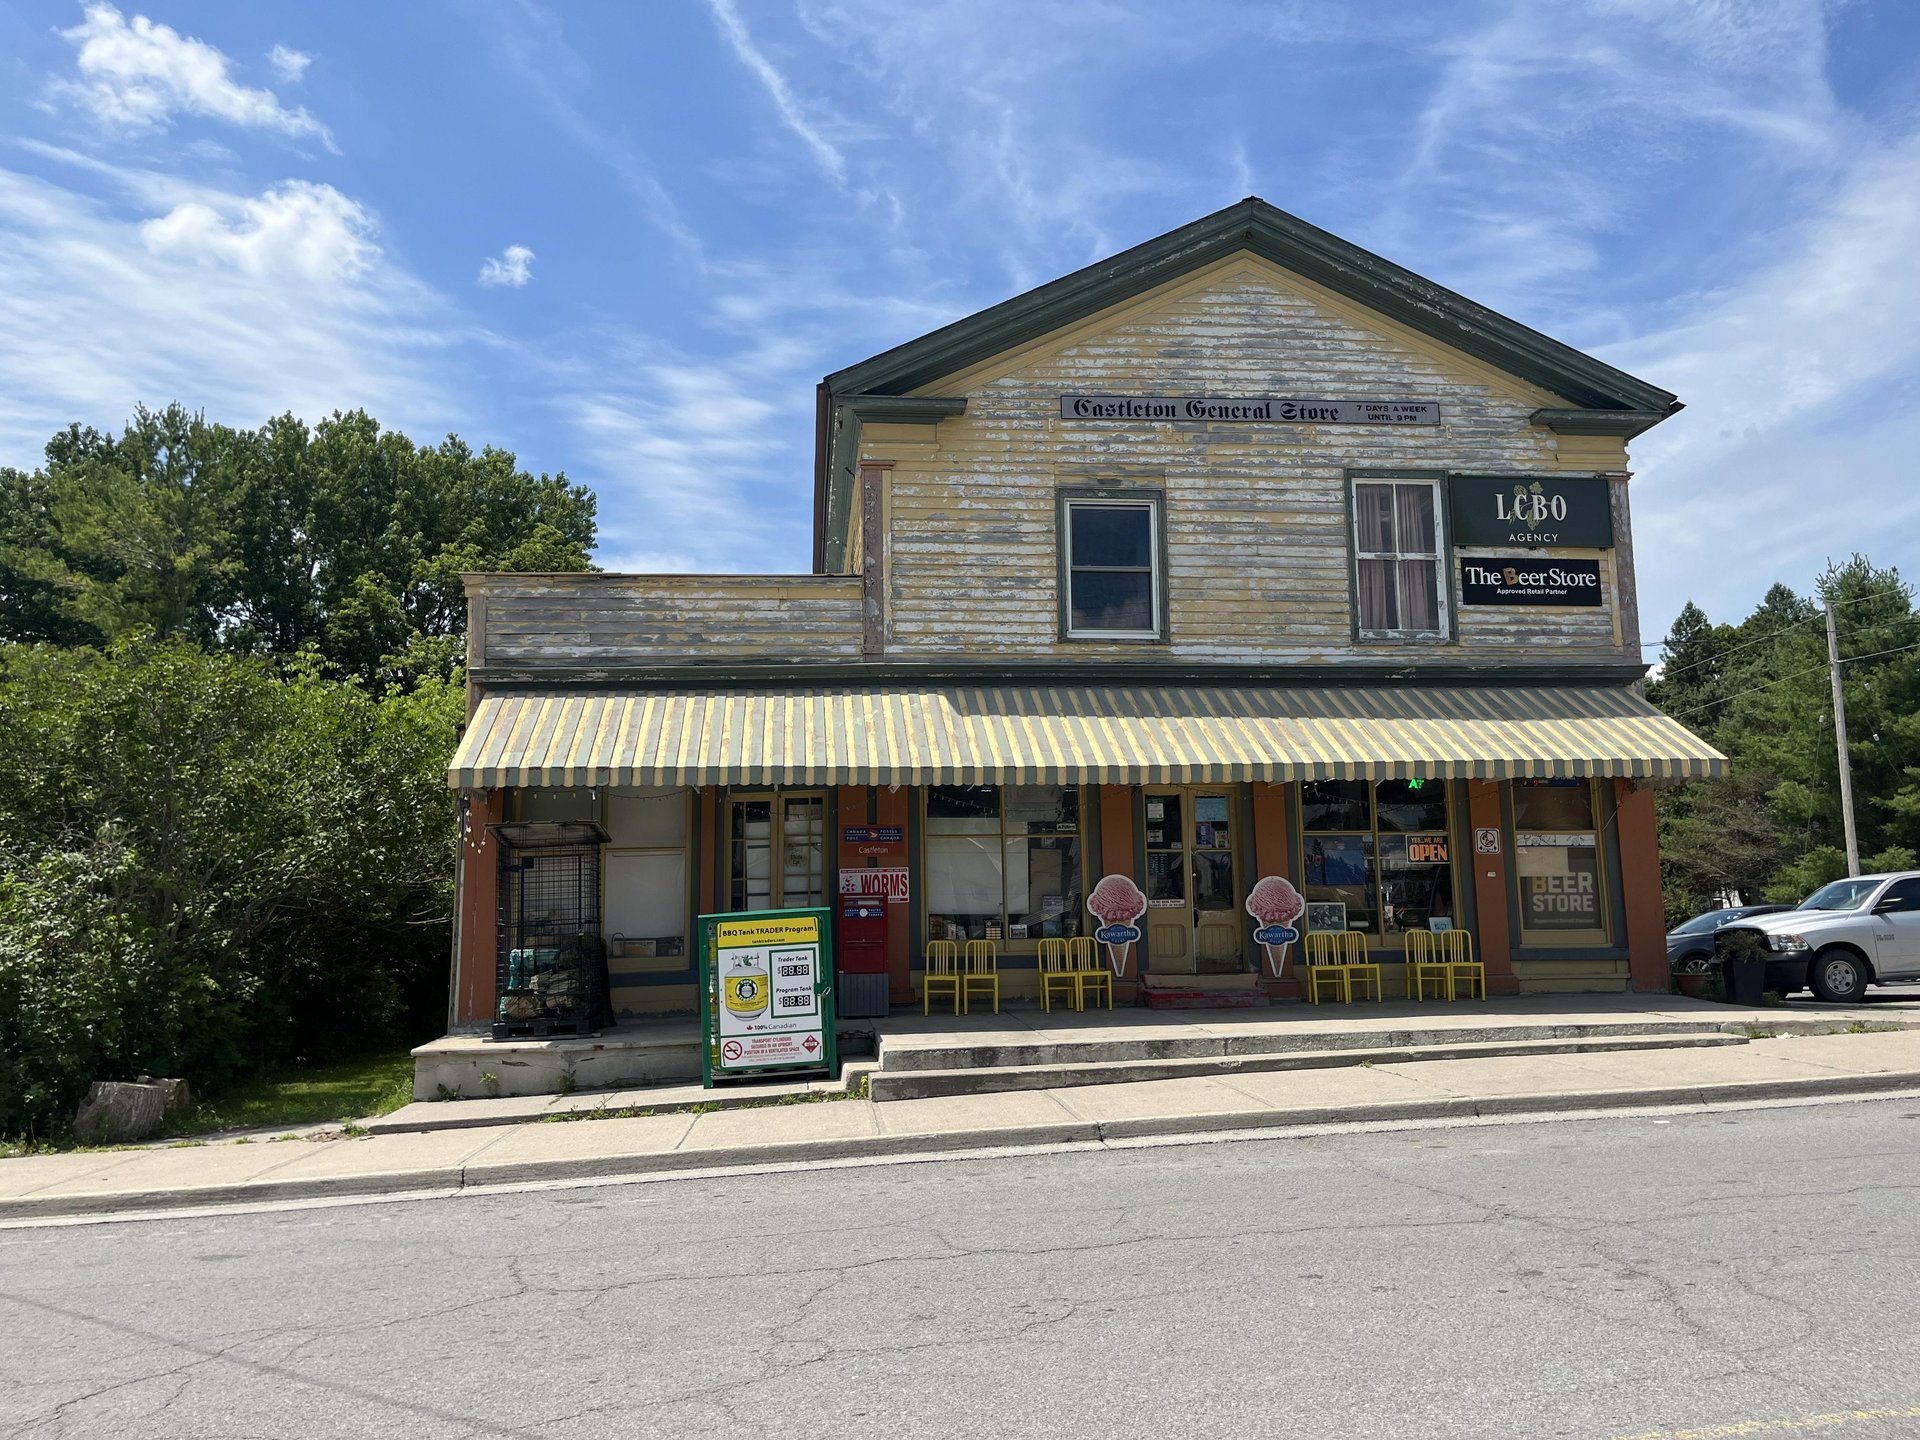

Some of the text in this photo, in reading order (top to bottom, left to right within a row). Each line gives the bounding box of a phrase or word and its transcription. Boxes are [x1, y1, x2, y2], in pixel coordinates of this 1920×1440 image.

[1073, 398, 1340, 421] Castleton General Store
[1495, 493, 1567, 521] LCBO
[1508, 533, 1559, 542] AGENCY
[1465, 566, 1597, 587] The Beer Store
[858, 846, 889, 854] Castleton
[1409, 844, 1448, 861] OPEN
[860, 873, 908, 896] WORMS
[1532, 872, 1593, 893] BEER
[1532, 894, 1594, 912] STORE
[722, 925, 814, 938] BBQ Tank TRADER Program
[1100, 929, 1136, 939] Kawartha
[1259, 930, 1294, 940] Kawartha
